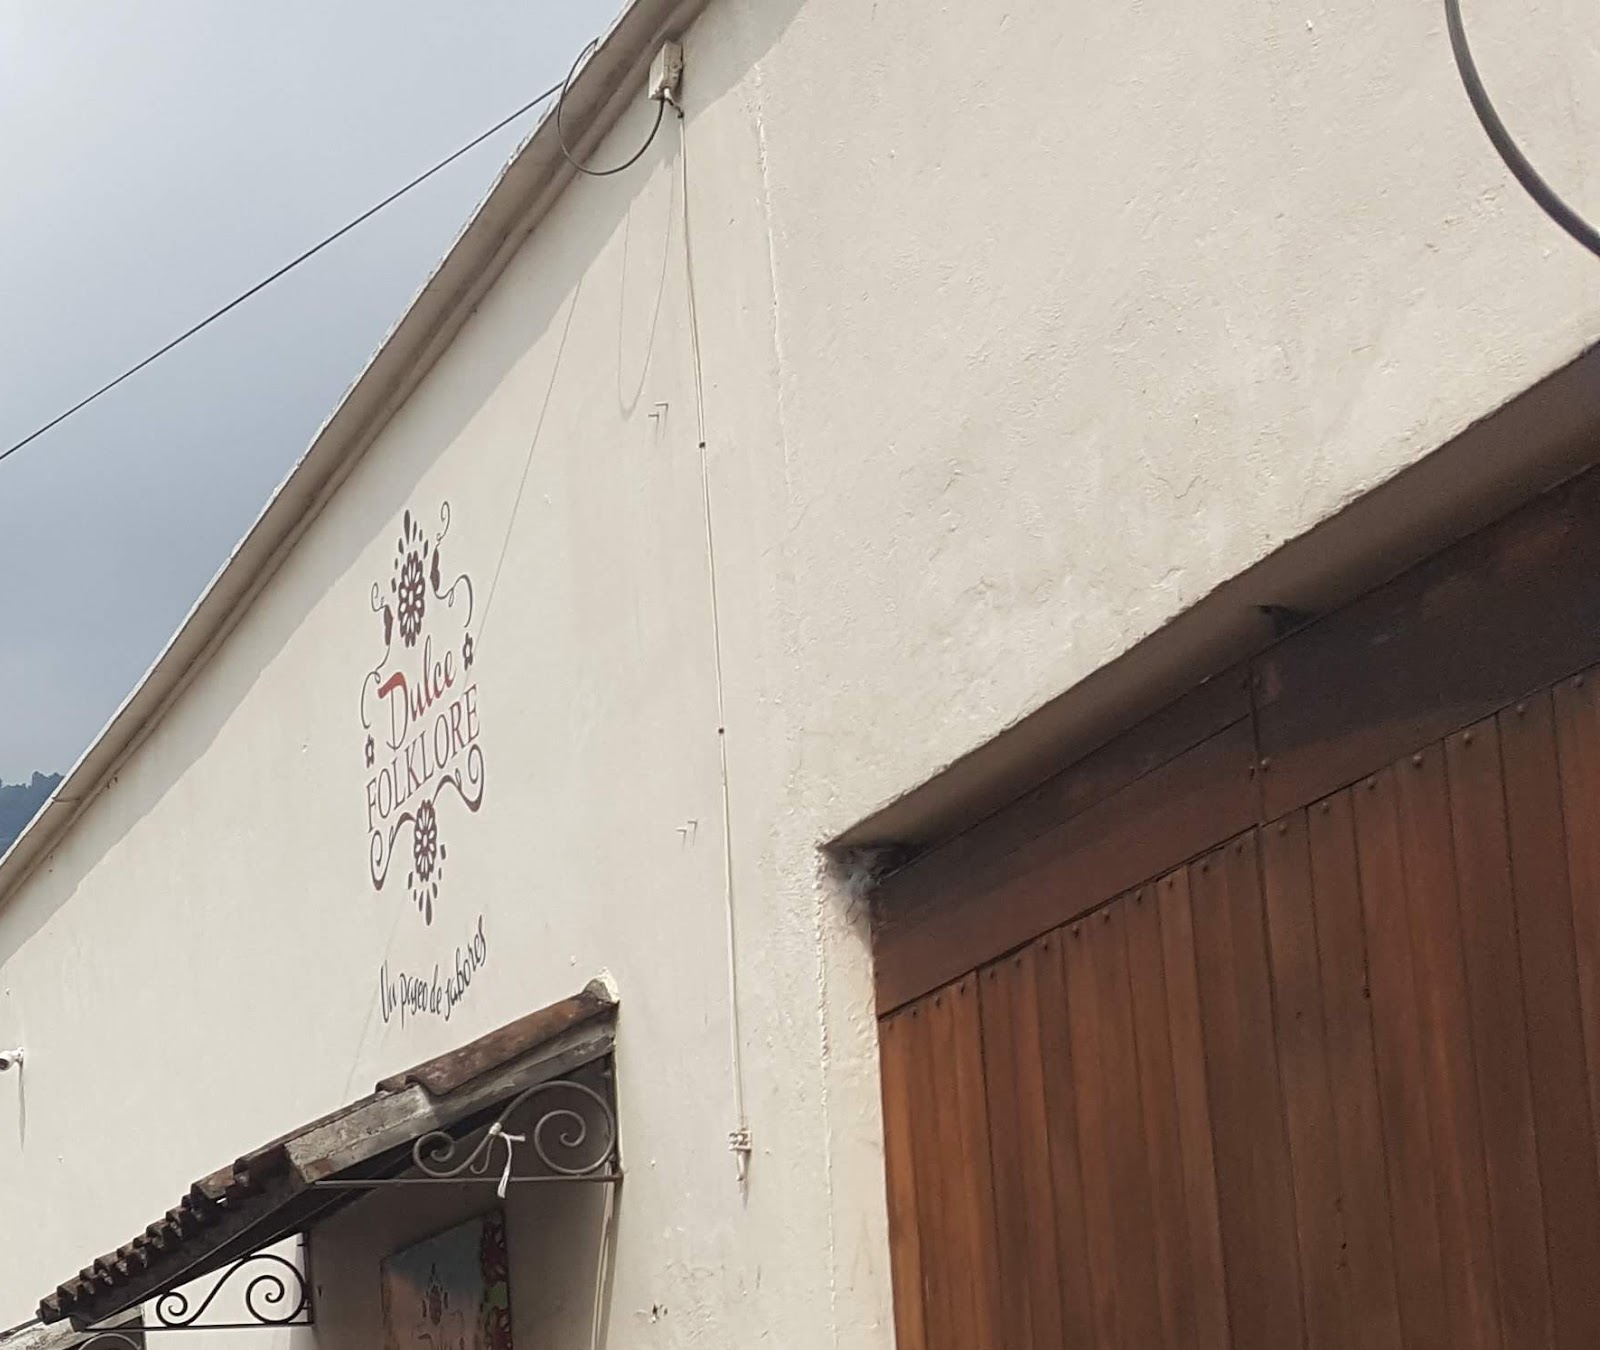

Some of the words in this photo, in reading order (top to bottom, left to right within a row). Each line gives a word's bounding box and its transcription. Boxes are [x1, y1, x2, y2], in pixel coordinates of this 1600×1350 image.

[378, 635, 456, 753] Dulce
[366, 683, 481, 833] FOLKLORE
[430, 964, 442, 1014] de
[445, 914, 487, 1021] sabores
